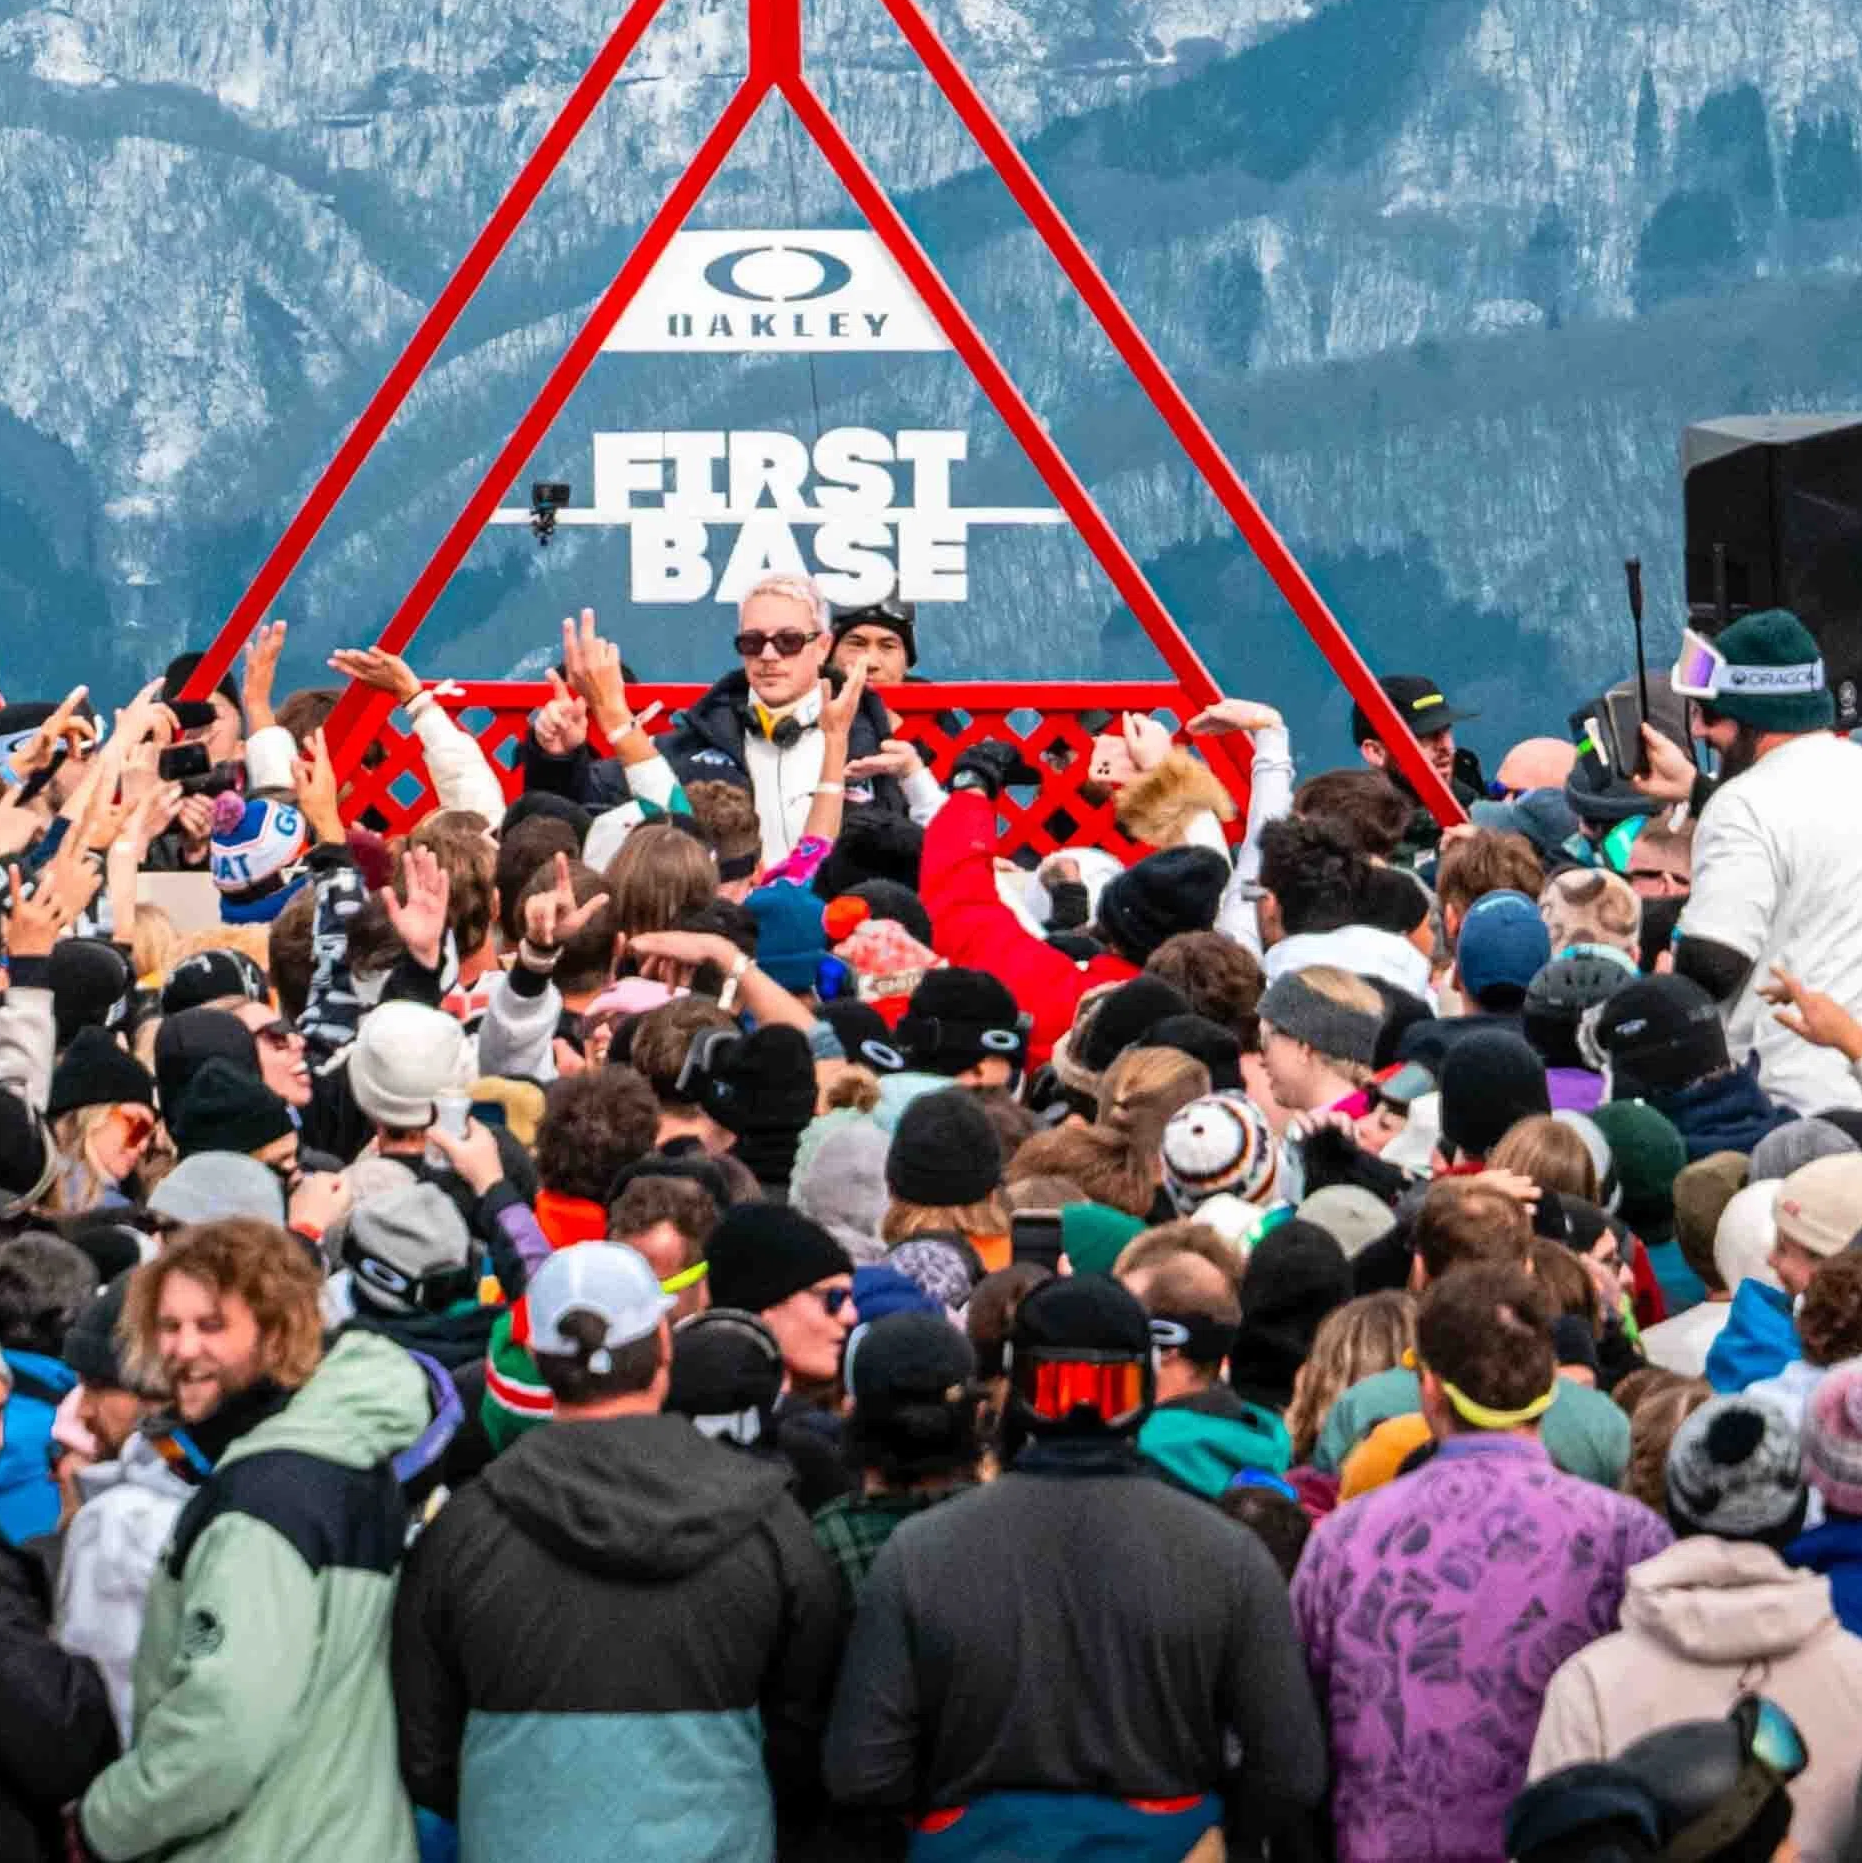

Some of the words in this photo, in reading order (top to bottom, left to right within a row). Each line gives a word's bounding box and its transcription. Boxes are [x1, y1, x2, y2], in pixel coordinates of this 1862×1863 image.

[667, 312, 891, 339] OAKLEY
[592, 426, 969, 518] FIRST
[630, 512, 969, 605] BASE
